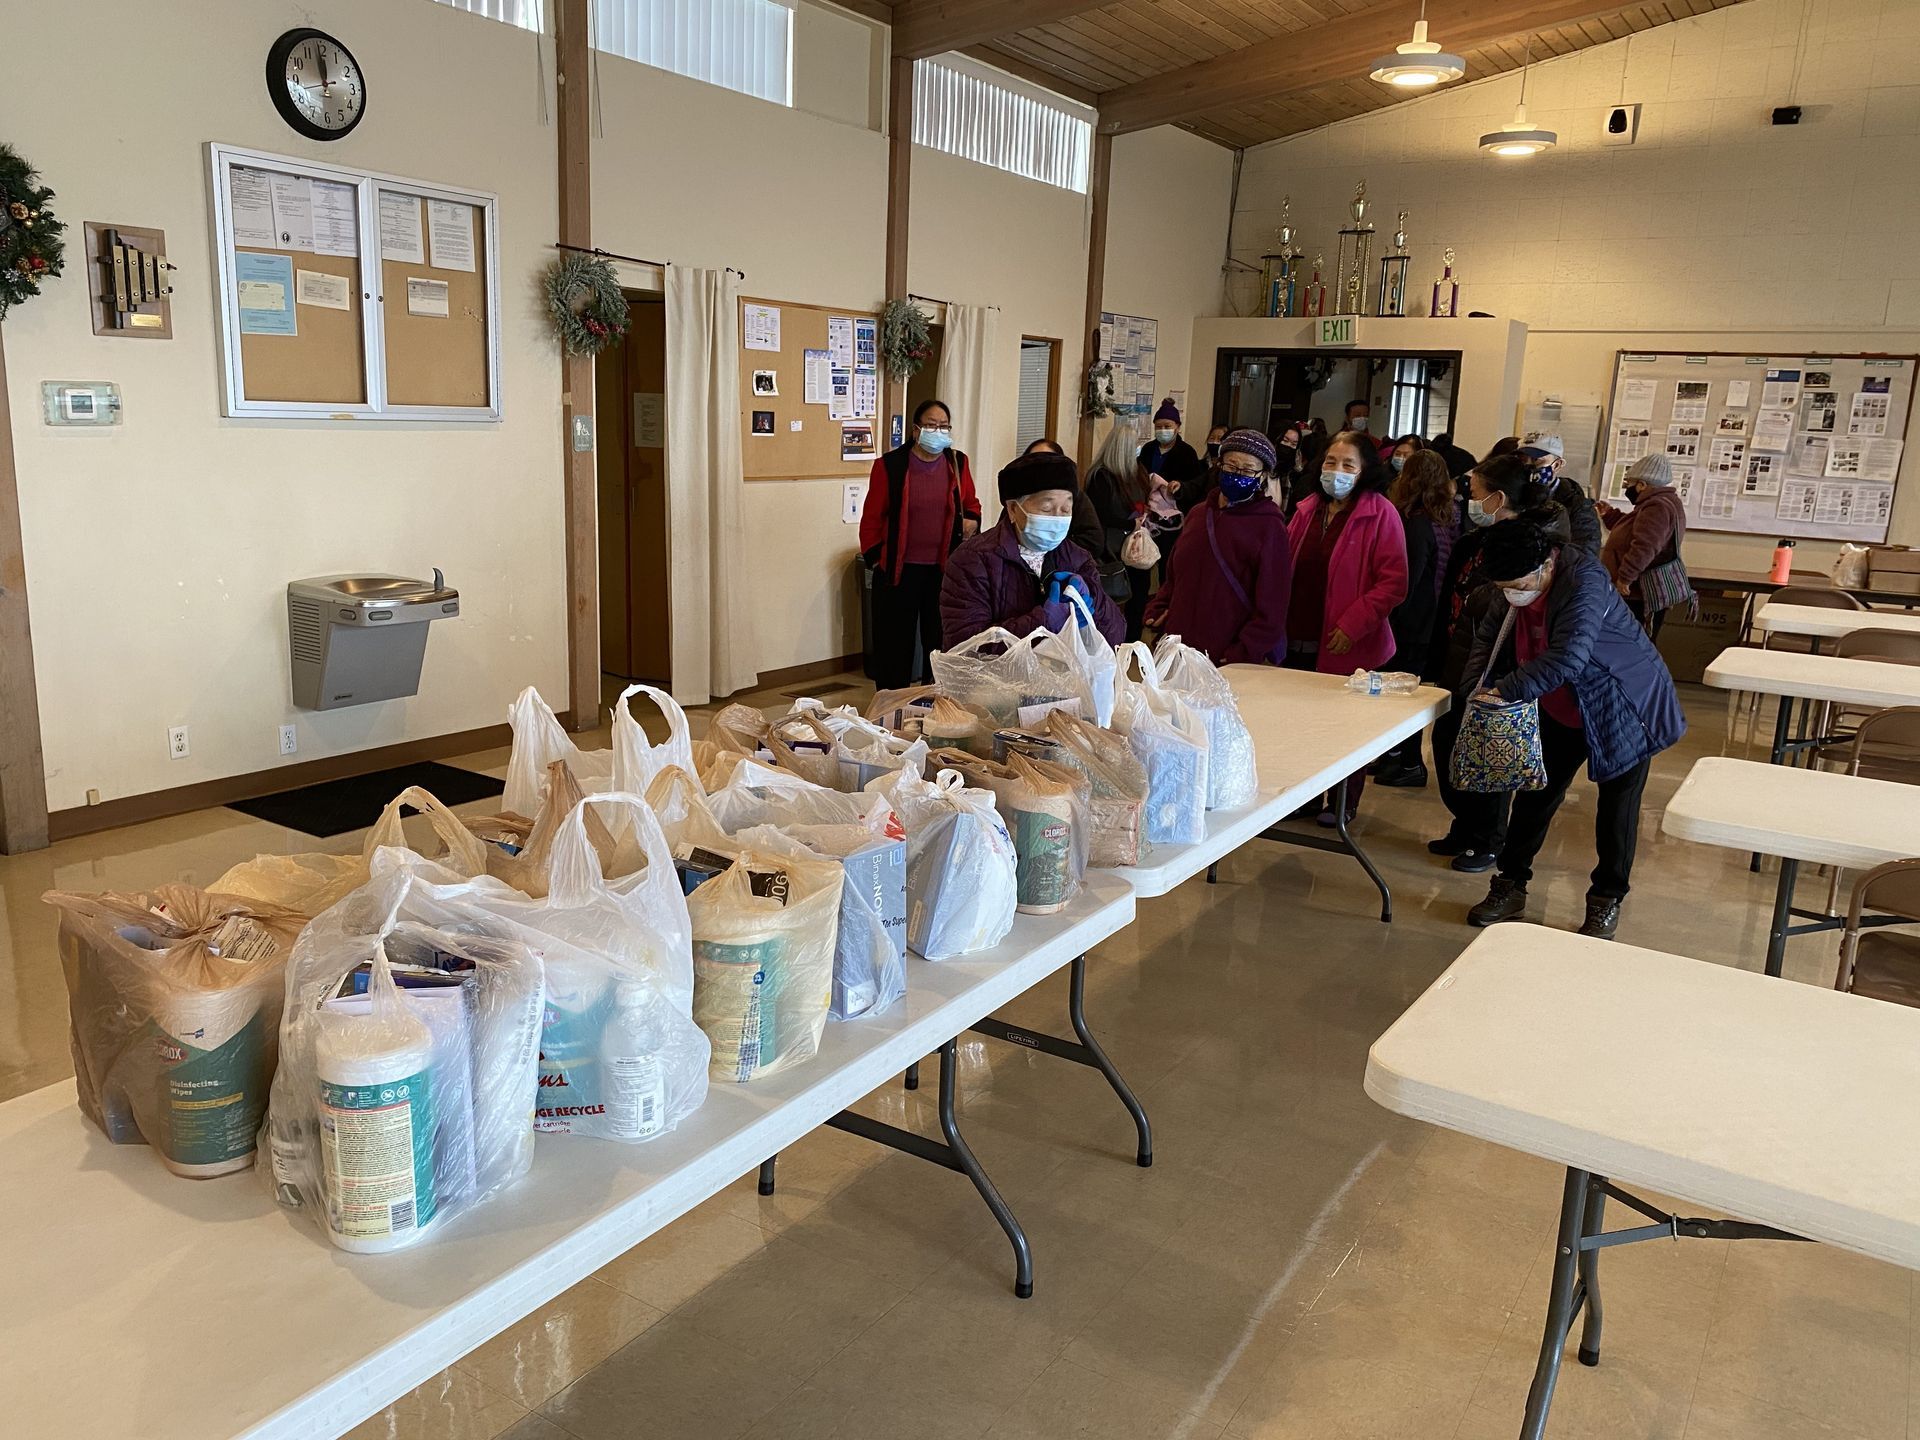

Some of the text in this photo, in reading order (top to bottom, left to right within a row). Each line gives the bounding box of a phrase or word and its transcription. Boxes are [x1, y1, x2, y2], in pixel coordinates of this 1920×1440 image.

[303, 46, 311, 59] 11
[334, 52, 338, 64] 1
[293, 57, 303, 70] 10
[344, 66, 350, 78] 2
[292, 74, 299, 85] 9
[349, 83, 356, 95] 3
[347, 99, 353, 111] 4
[309, 106, 316, 118] 7
[324, 111, 331, 124] 6
[337, 109, 344, 121] 5
[1323, 319, 1351, 342] EXIT
[1702, 612, 1727, 624] N95
[170, 1080, 219, 1089] Disinfecting
[170, 1088, 193, 1097] Wipes
[555, 1104, 606, 1117] RECYCLE
